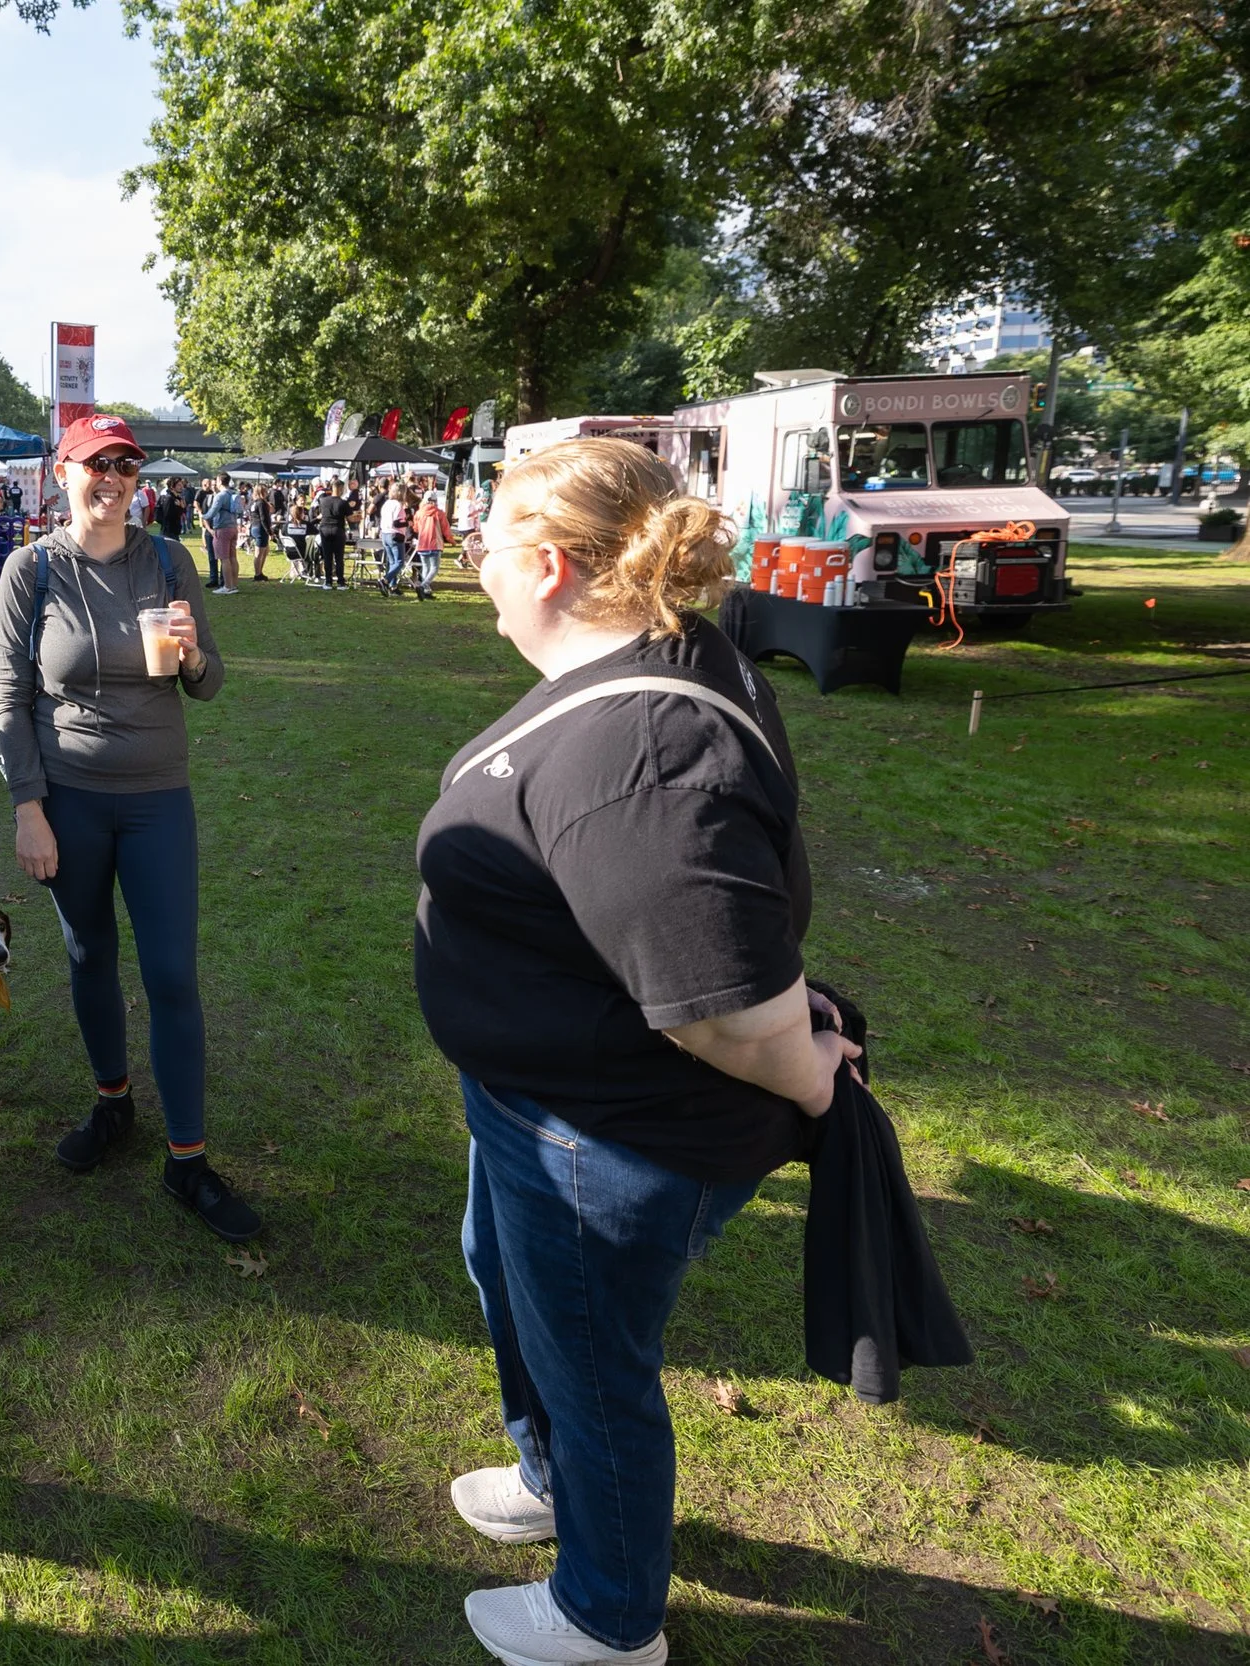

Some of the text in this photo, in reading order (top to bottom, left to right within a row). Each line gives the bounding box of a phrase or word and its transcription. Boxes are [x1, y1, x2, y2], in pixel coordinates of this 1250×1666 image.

[865, 392, 999, 412] BONDI BOWLS
[883, 495, 1015, 508] BRINGING THE
[889, 503, 1030, 517] BEACH TO YOU
